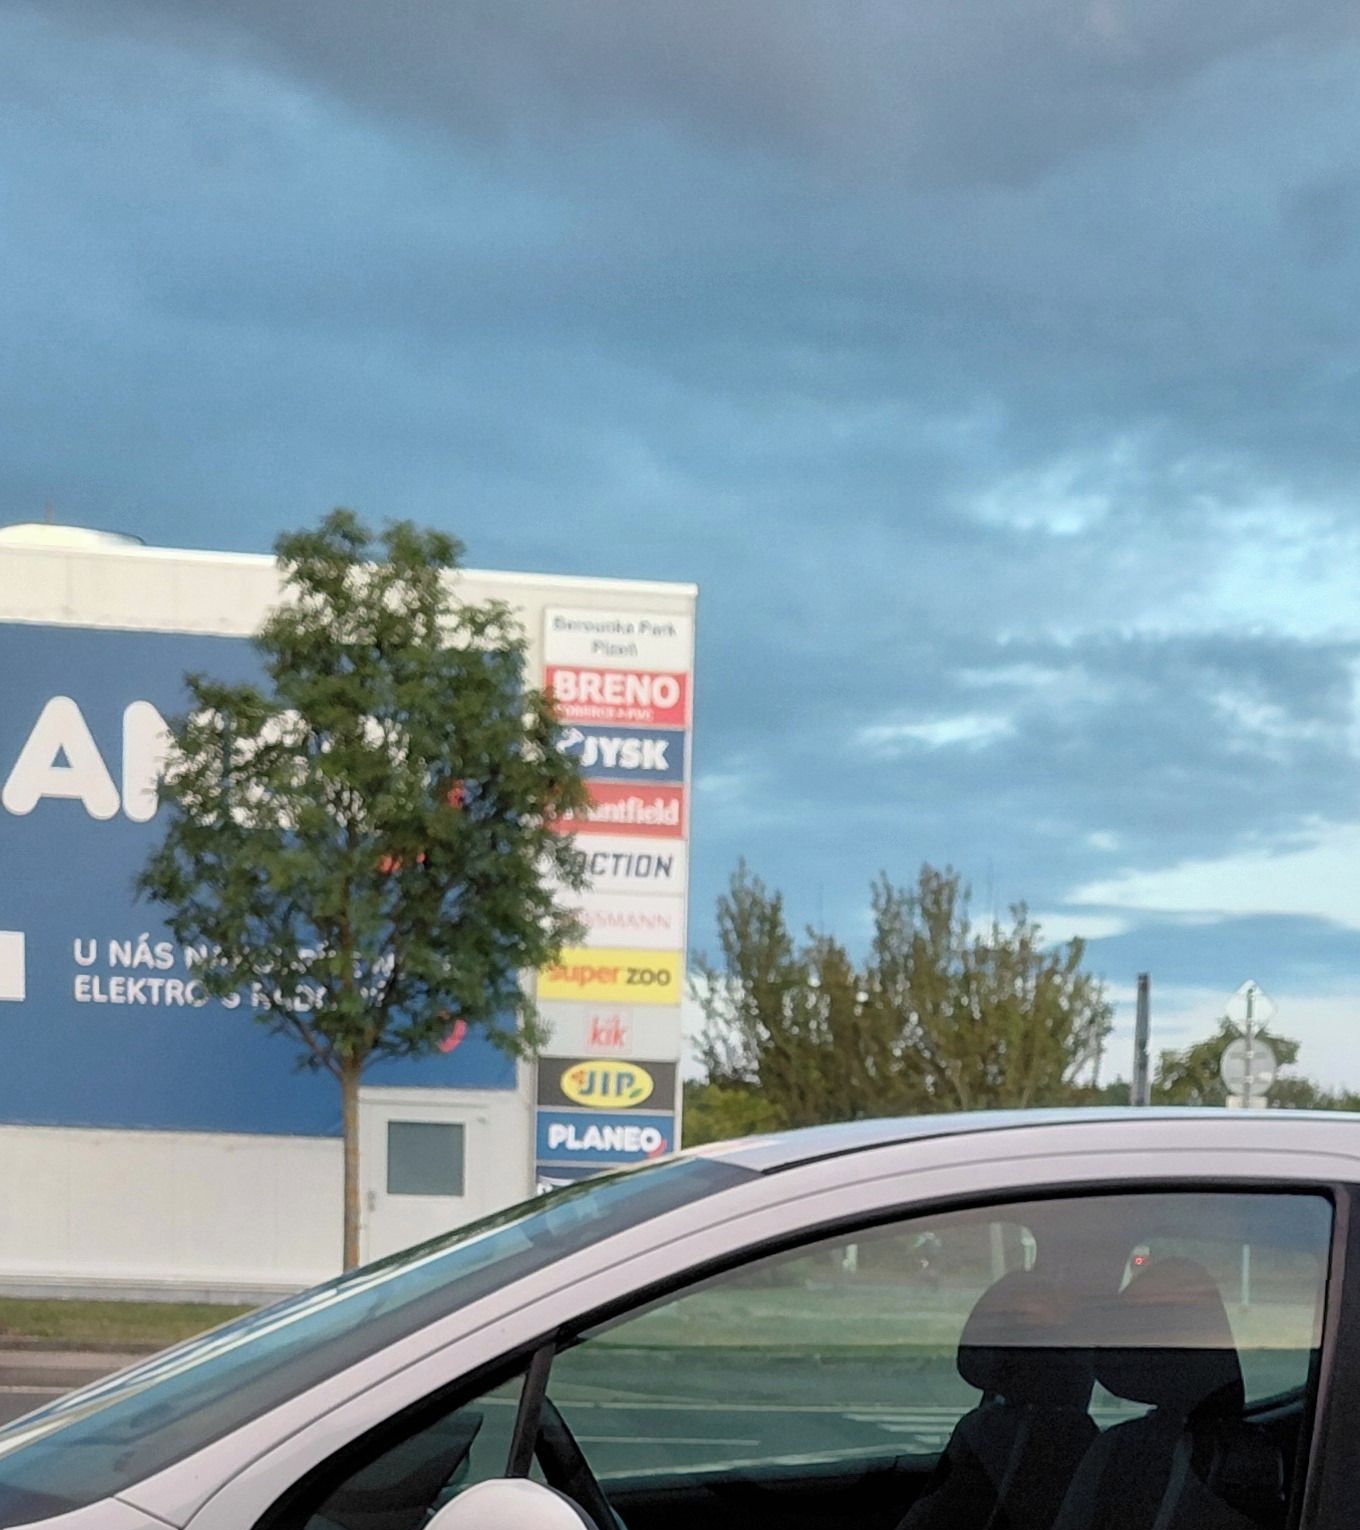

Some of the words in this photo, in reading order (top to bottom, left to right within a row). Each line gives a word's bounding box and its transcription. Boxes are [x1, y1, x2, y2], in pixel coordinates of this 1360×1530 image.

[553, 670, 680, 709] BRENO
[581, 735, 669, 770] JYSK
[74, 938, 97, 966] U
[109, 932, 174, 970] NÁS
[74, 974, 208, 1008] ELEKTRO
[626, 967, 671, 986] zoo
[579, 1071, 635, 1097] JIP
[548, 1123, 663, 1153] PLANEO
